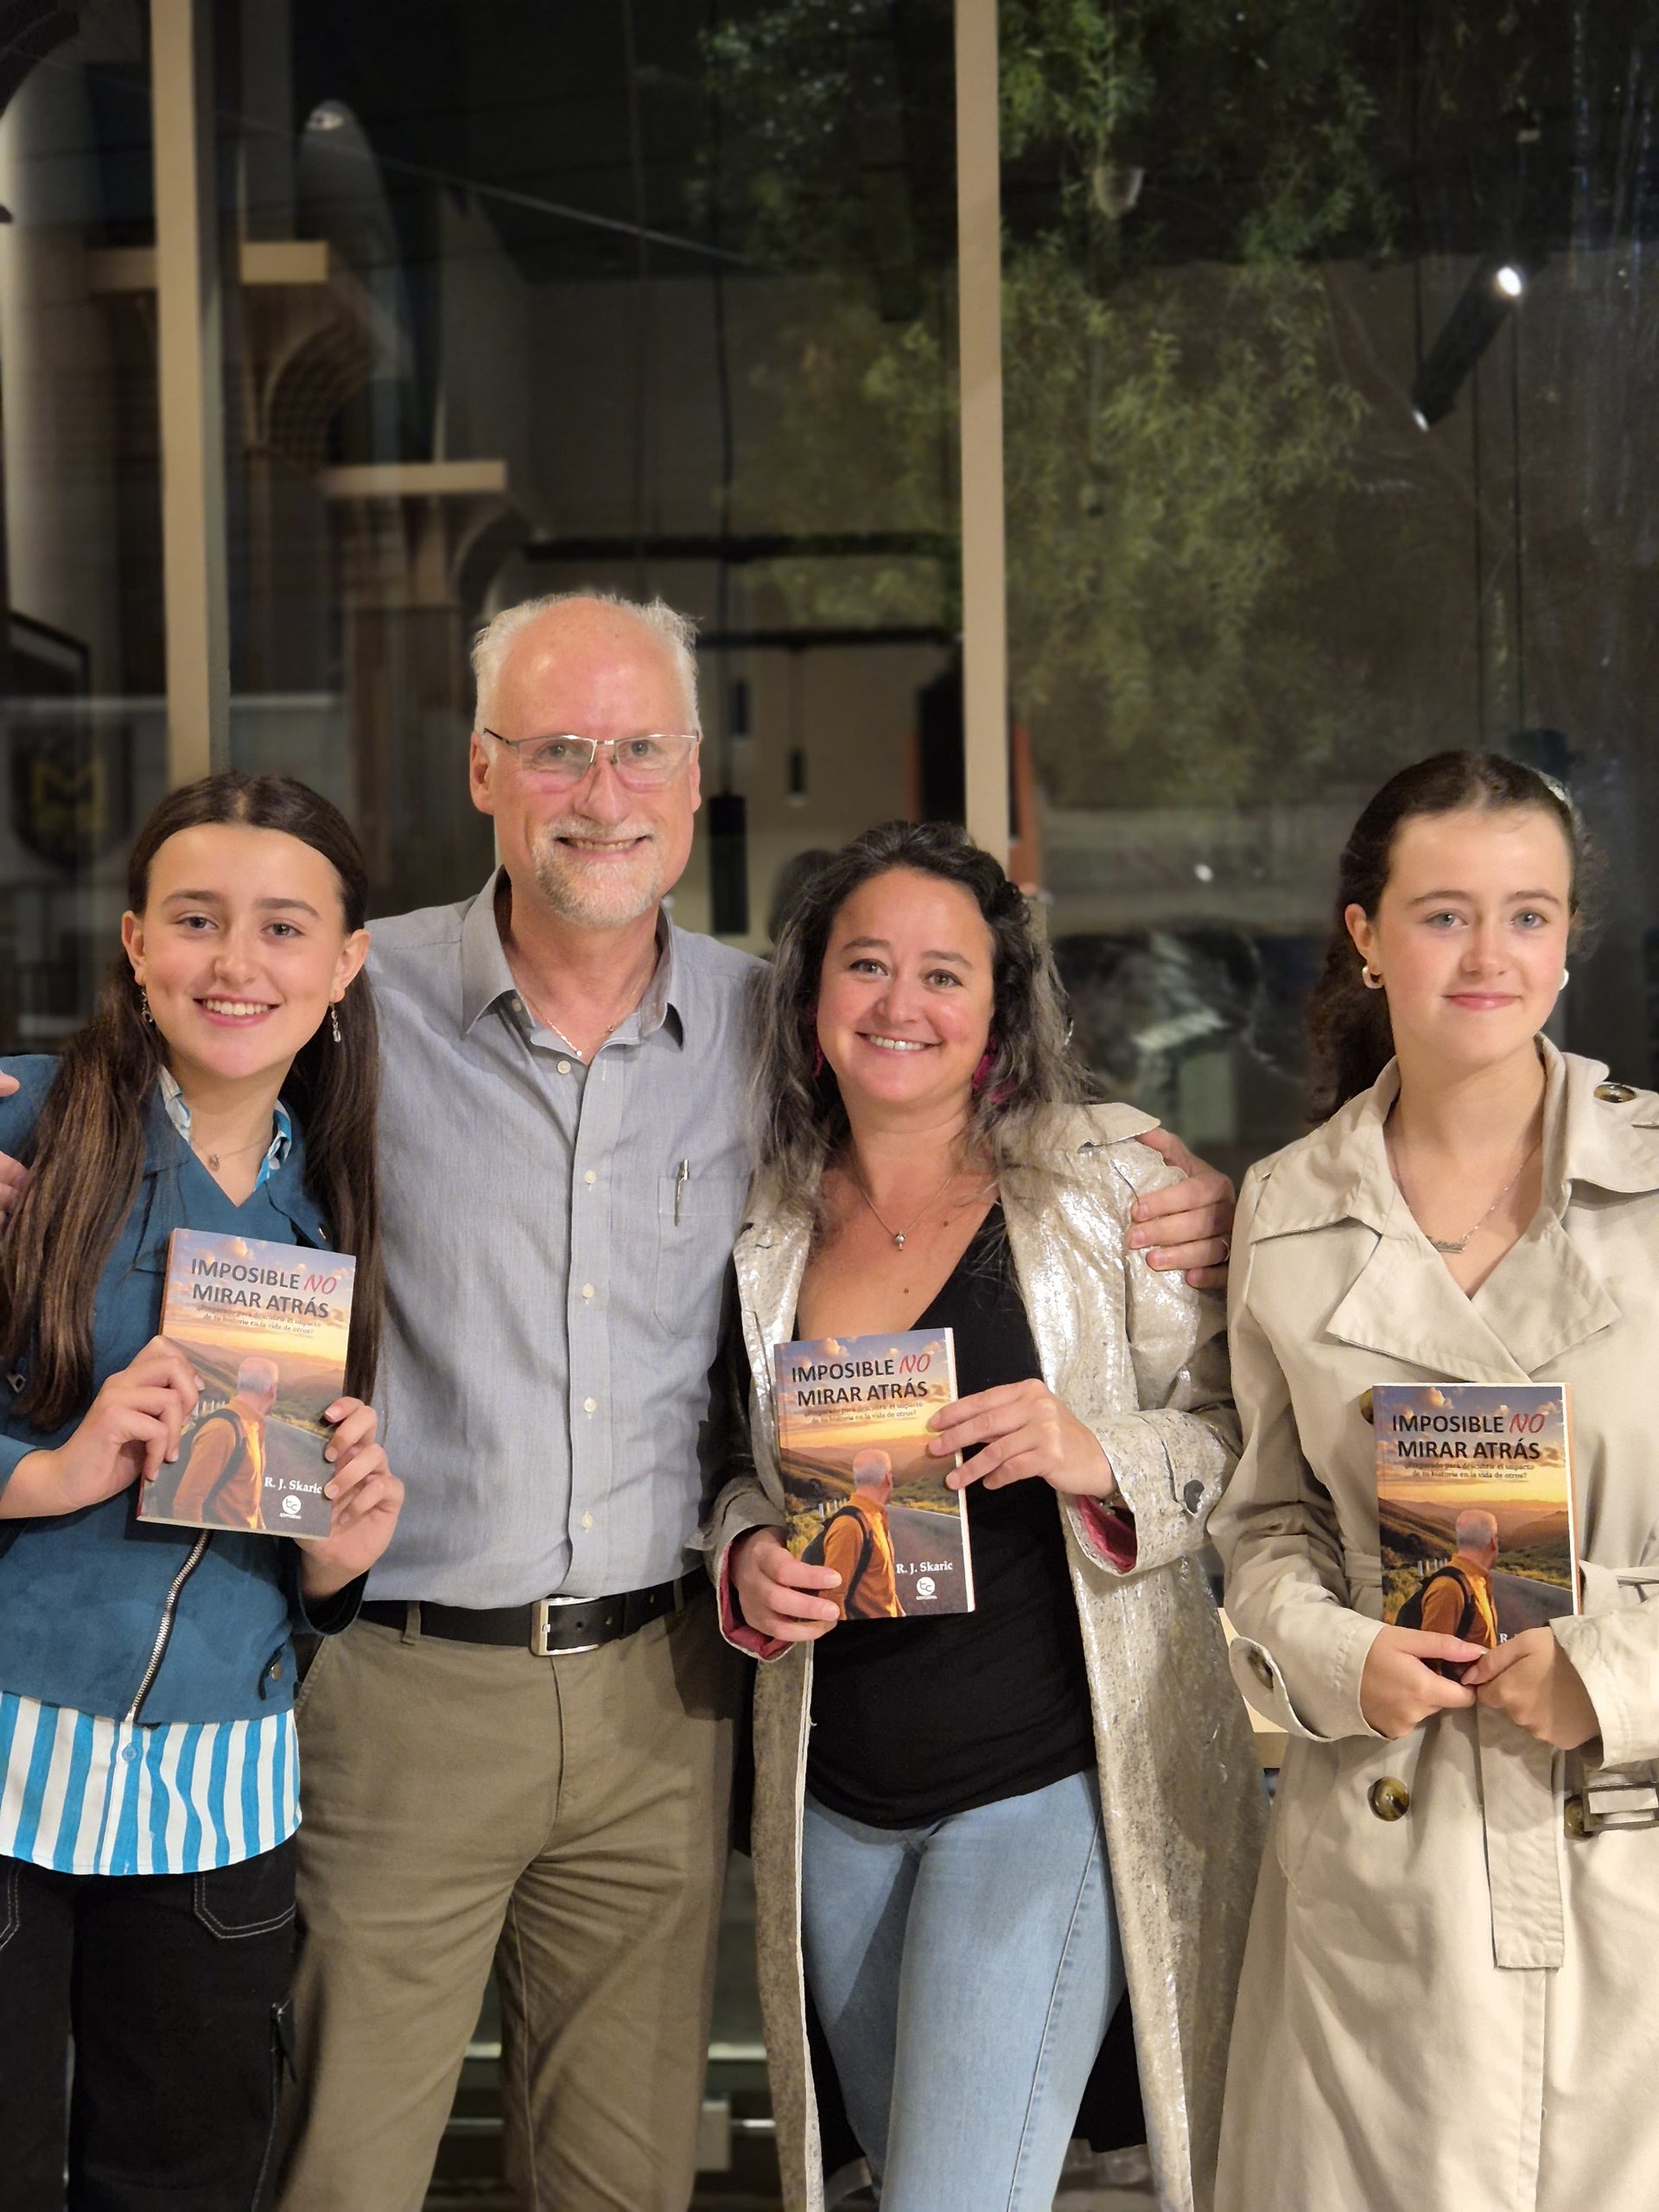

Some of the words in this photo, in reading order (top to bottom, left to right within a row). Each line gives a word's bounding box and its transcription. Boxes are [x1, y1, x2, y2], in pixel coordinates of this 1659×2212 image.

[191, 1258, 301, 1290] IMPOSIBLE
[303, 1273, 337, 1295] NO
[193, 1283, 262, 1309] MIRAR
[265, 1294, 329, 1319] ATRÁS
[791, 1359, 895, 1383] IMPOSIBLE
[899, 1353, 931, 1375] NO
[798, 1386, 863, 1407] MIRAR
[867, 1378, 929, 1402] ATRÁS
[1392, 1414, 1504, 1433] IMPOSIBLE
[1509, 1413, 1546, 1434] NO
[1397, 1440, 1468, 1459] MIRAR
[1472, 1438, 1541, 1459] ATRÁS
[264, 1476, 276, 1488] R.
[277, 1478, 286, 1491] J.
[289, 1479, 322, 1494] Skaric
[896, 1563, 907, 1574] R.
[909, 1562, 918, 1575] J.
[919, 1560, 953, 1573] Skaric
